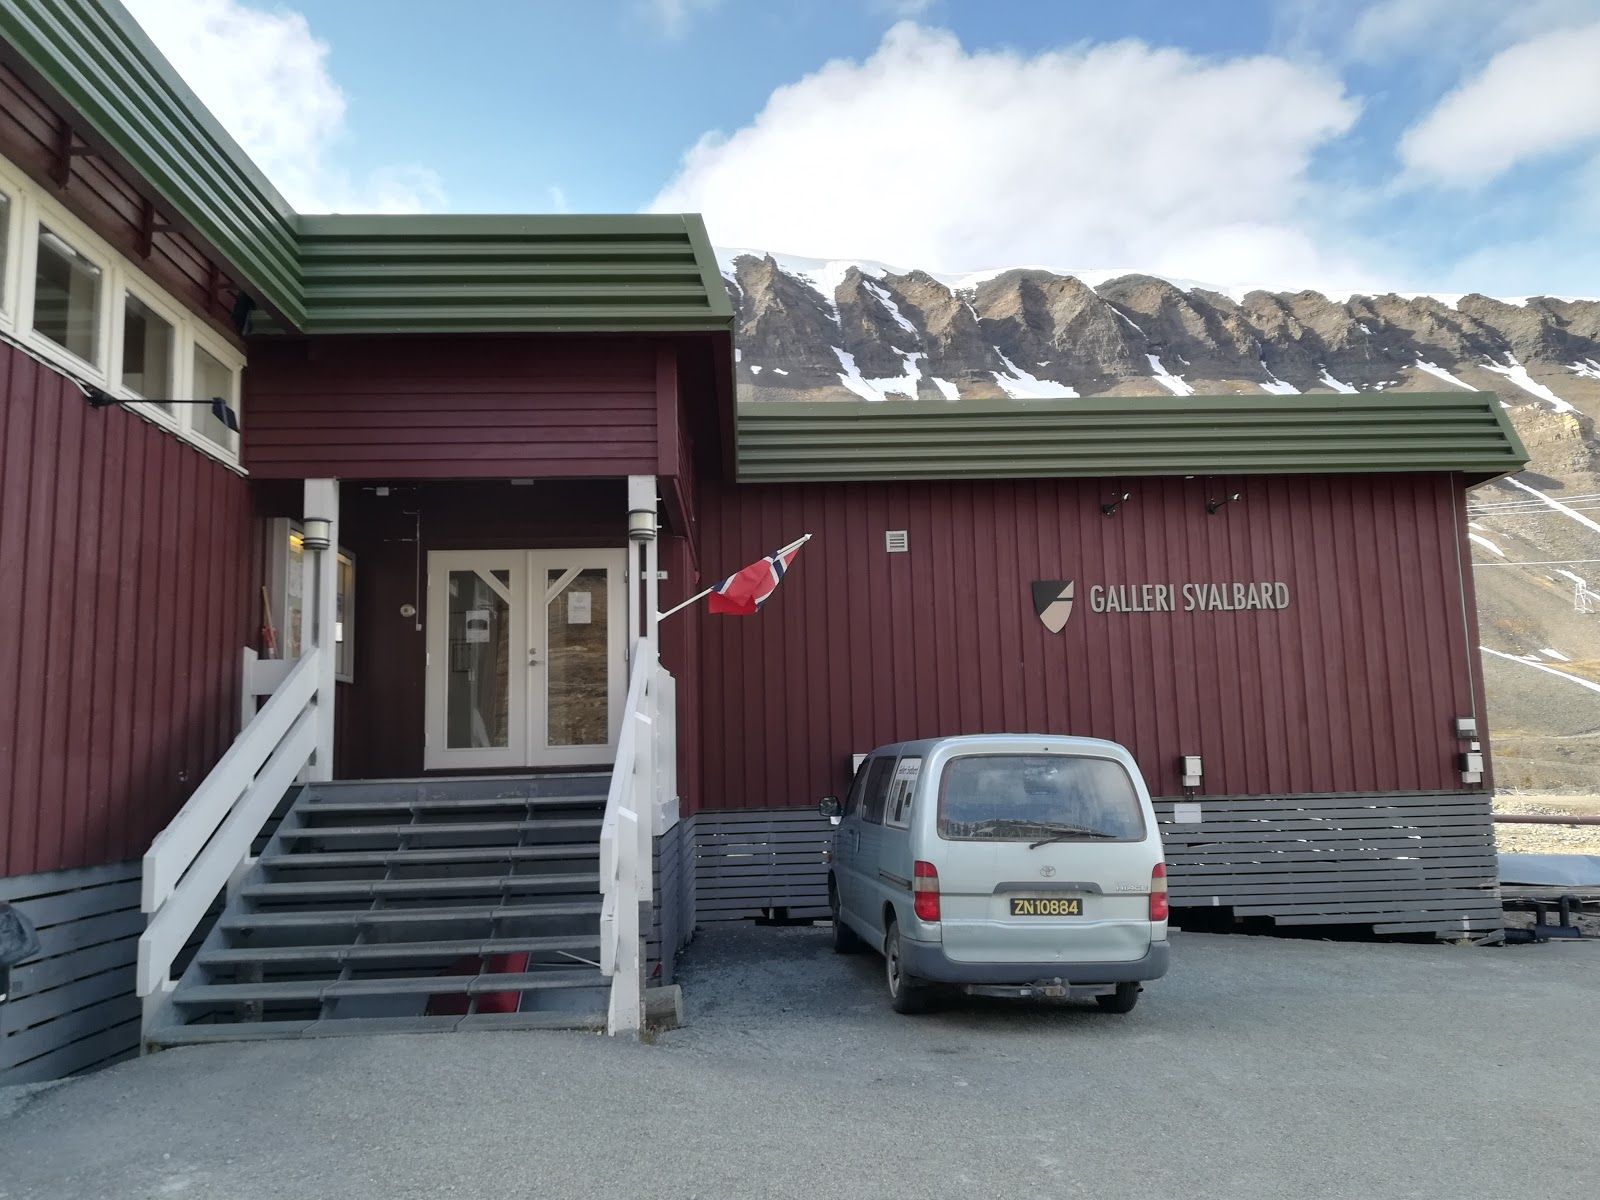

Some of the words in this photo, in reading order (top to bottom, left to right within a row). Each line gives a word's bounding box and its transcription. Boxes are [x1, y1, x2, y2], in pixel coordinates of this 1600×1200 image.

[1090, 584, 1175, 612] GALLERI
[1182, 582, 1289, 610] SVALBARD
[1014, 900, 1078, 914] ZN10884
